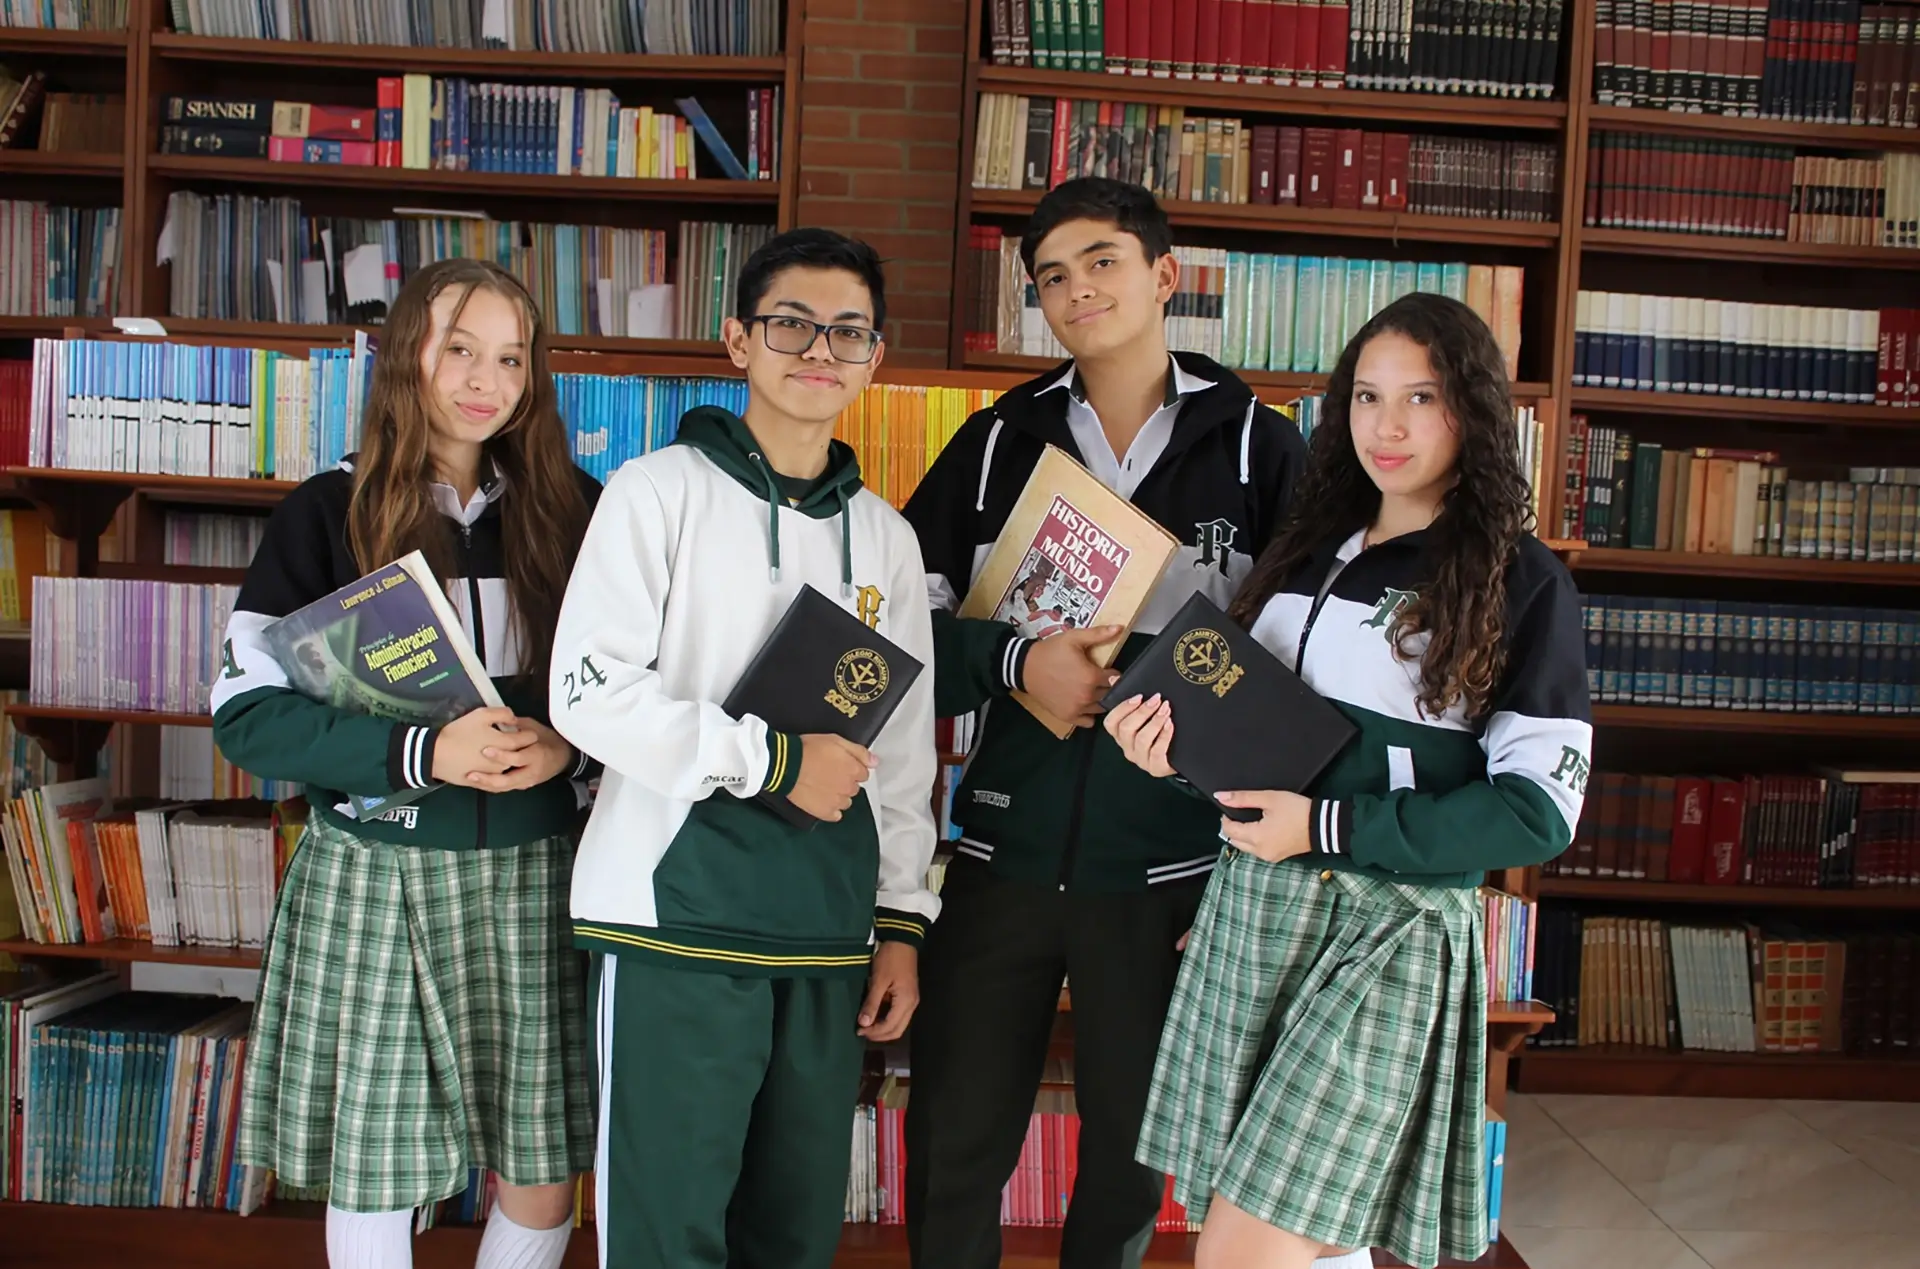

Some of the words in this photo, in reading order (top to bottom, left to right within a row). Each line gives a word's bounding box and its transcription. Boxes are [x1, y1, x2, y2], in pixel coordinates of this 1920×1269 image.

[186, 101, 257, 120] SPANISH
[1050, 500, 1124, 569] HISTORIA
[1062, 530, 1094, 567] DEL
[1193, 518, 1238, 582] R
[1040, 535, 1104, 594] MUNDO
[364, 624, 439, 671] Administración
[382, 648, 438, 684] Financiera
[1176, 642, 1188, 675] COLEGIO
[1183, 630, 1220, 643] RICAURTE
[563, 654, 608, 711] 24
[842, 650, 873, 664] COLEGIO
[874, 655, 888, 690] RICAURTE
[1211, 663, 1245, 698] 2024
[823, 688, 859, 719] 2024
[701, 775, 745, 785] Oscar
